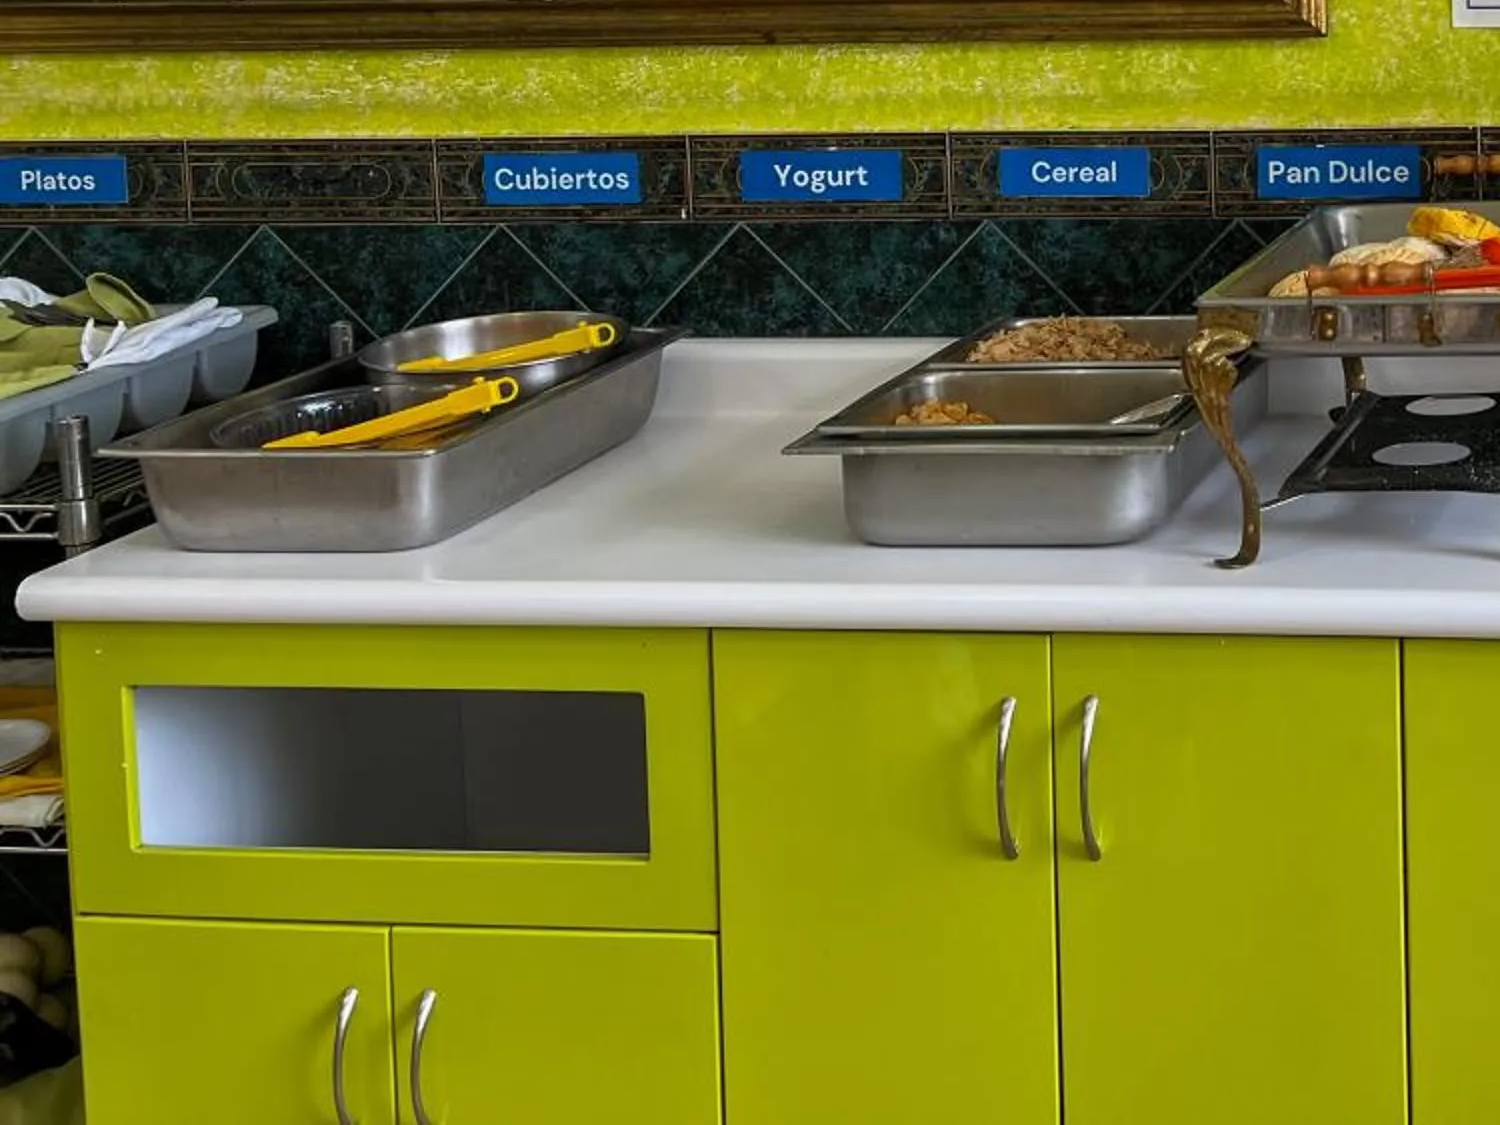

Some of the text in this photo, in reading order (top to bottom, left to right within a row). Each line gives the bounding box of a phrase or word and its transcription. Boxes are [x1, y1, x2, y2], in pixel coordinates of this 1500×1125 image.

[20, 169, 96, 191] Platos
[494, 166, 630, 191] Cubiertos
[773, 163, 868, 194] Yogurt
[1030, 160, 1118, 184] Cereal
[1268, 159, 1410, 185] Pan Dulce
